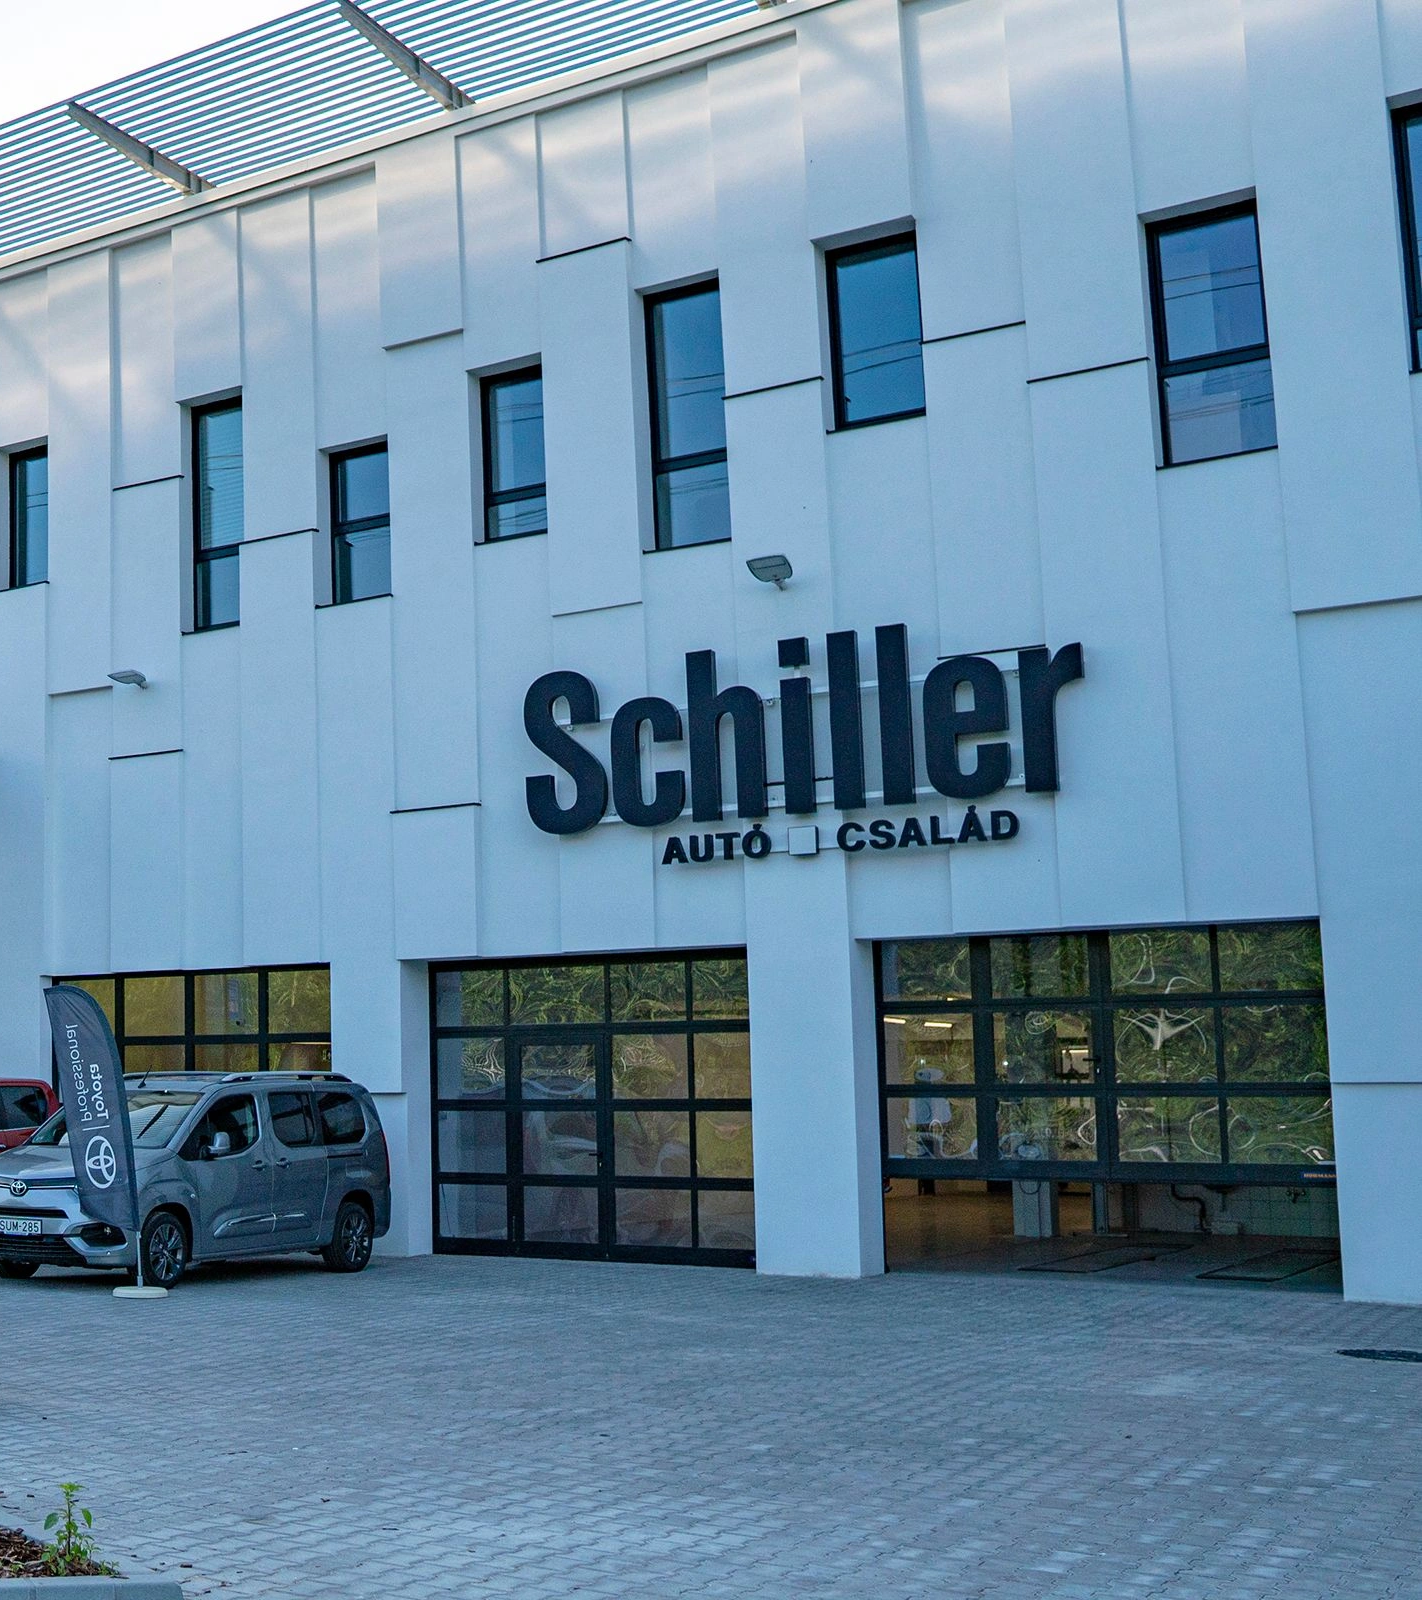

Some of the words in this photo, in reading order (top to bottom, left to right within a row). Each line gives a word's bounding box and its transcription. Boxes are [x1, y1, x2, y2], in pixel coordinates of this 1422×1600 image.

[523, 623, 1085, 835] Schiller
[662, 823, 772, 865] AUTÓ
[836, 805, 1020, 853] CSALÁD
[0, 1220, 40, 1233] SUM-285
